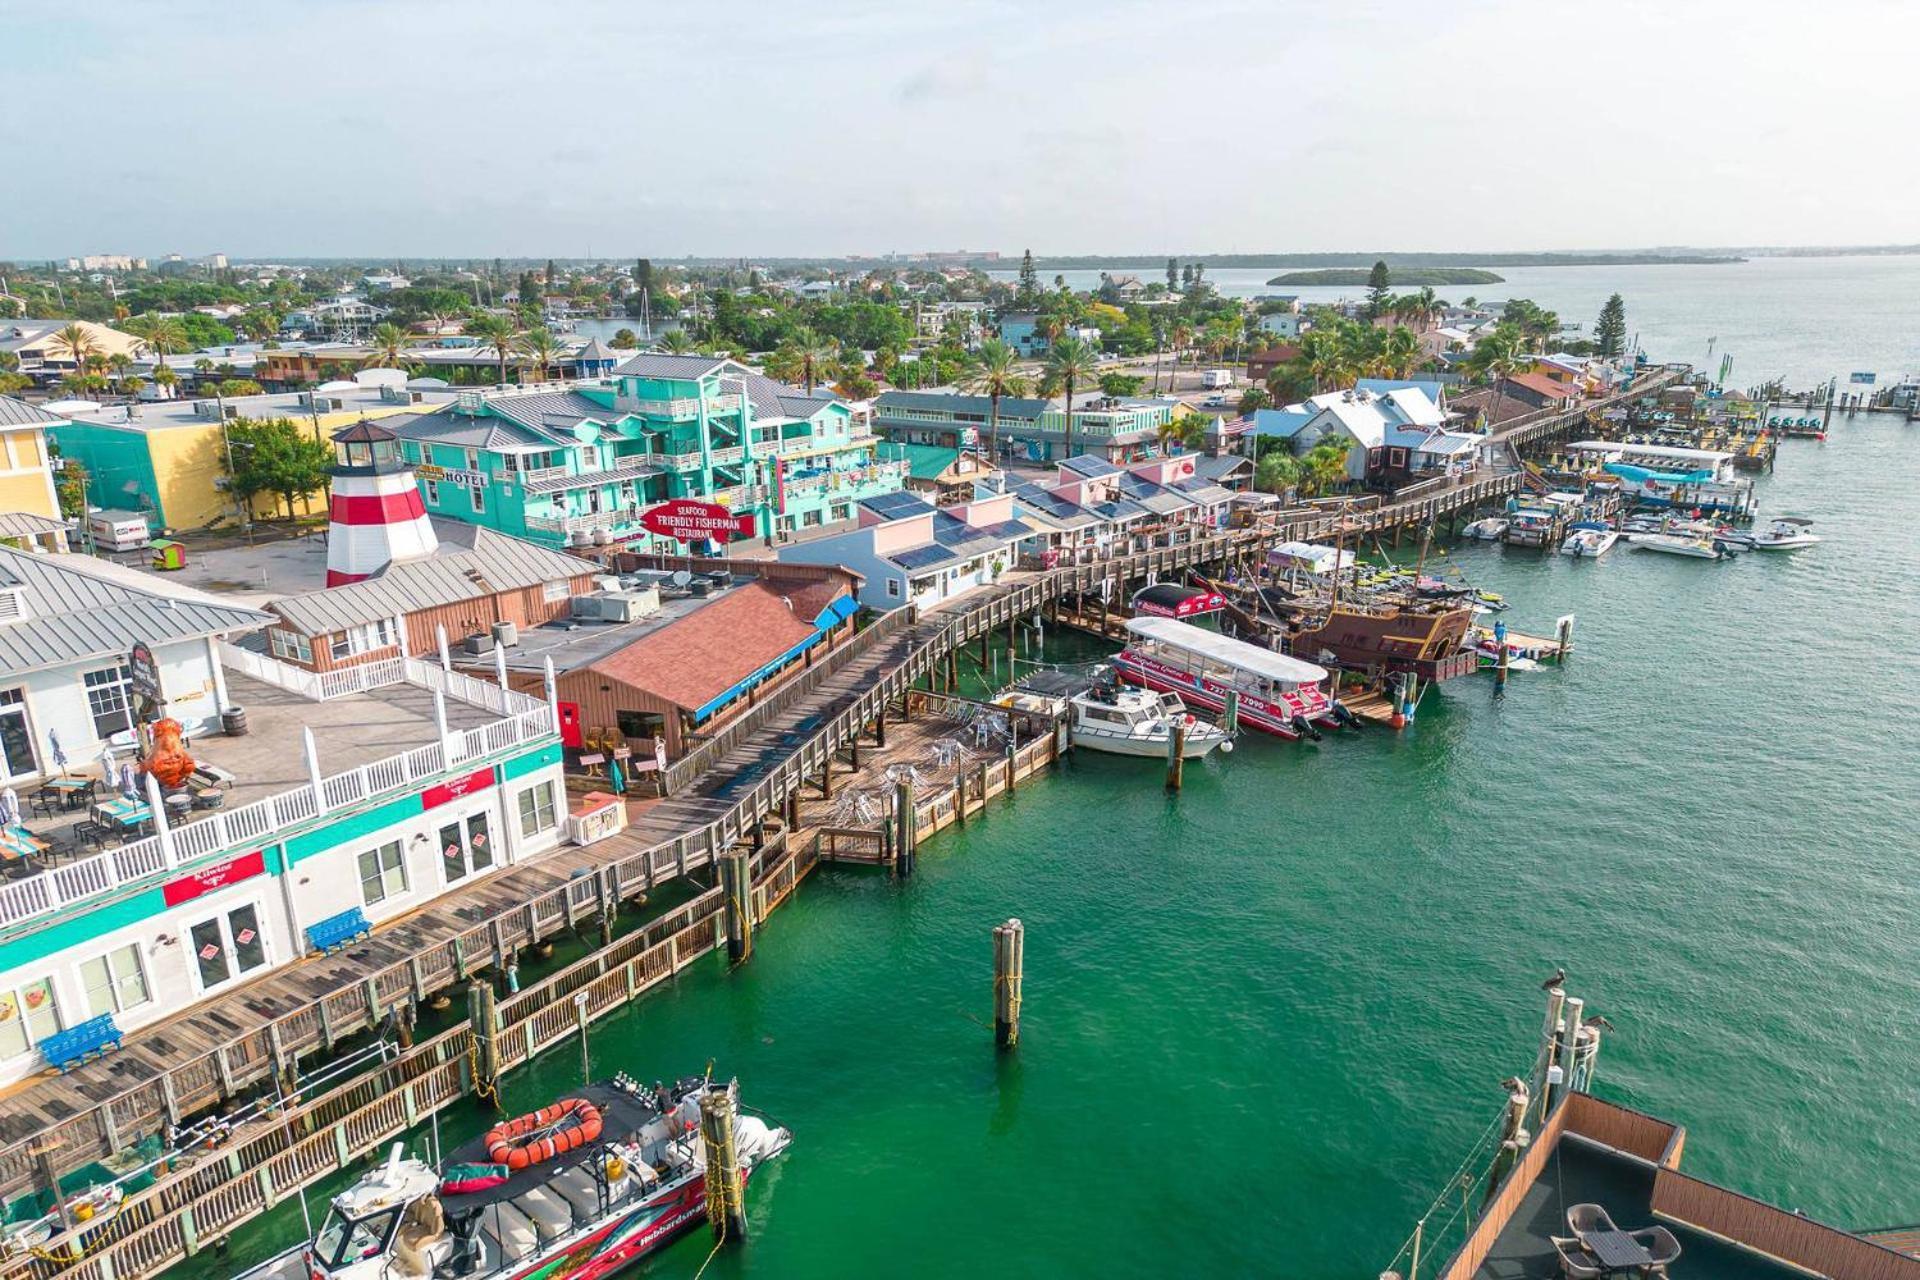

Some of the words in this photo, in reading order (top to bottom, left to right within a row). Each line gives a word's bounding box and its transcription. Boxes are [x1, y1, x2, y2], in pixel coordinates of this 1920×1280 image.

[446, 472, 485, 486] HOTEL
[677, 506, 708, 516] SEAFOOD
[695, 517, 740, 530] FISHERMAN
[673, 527, 713, 538] RESTAURANT
